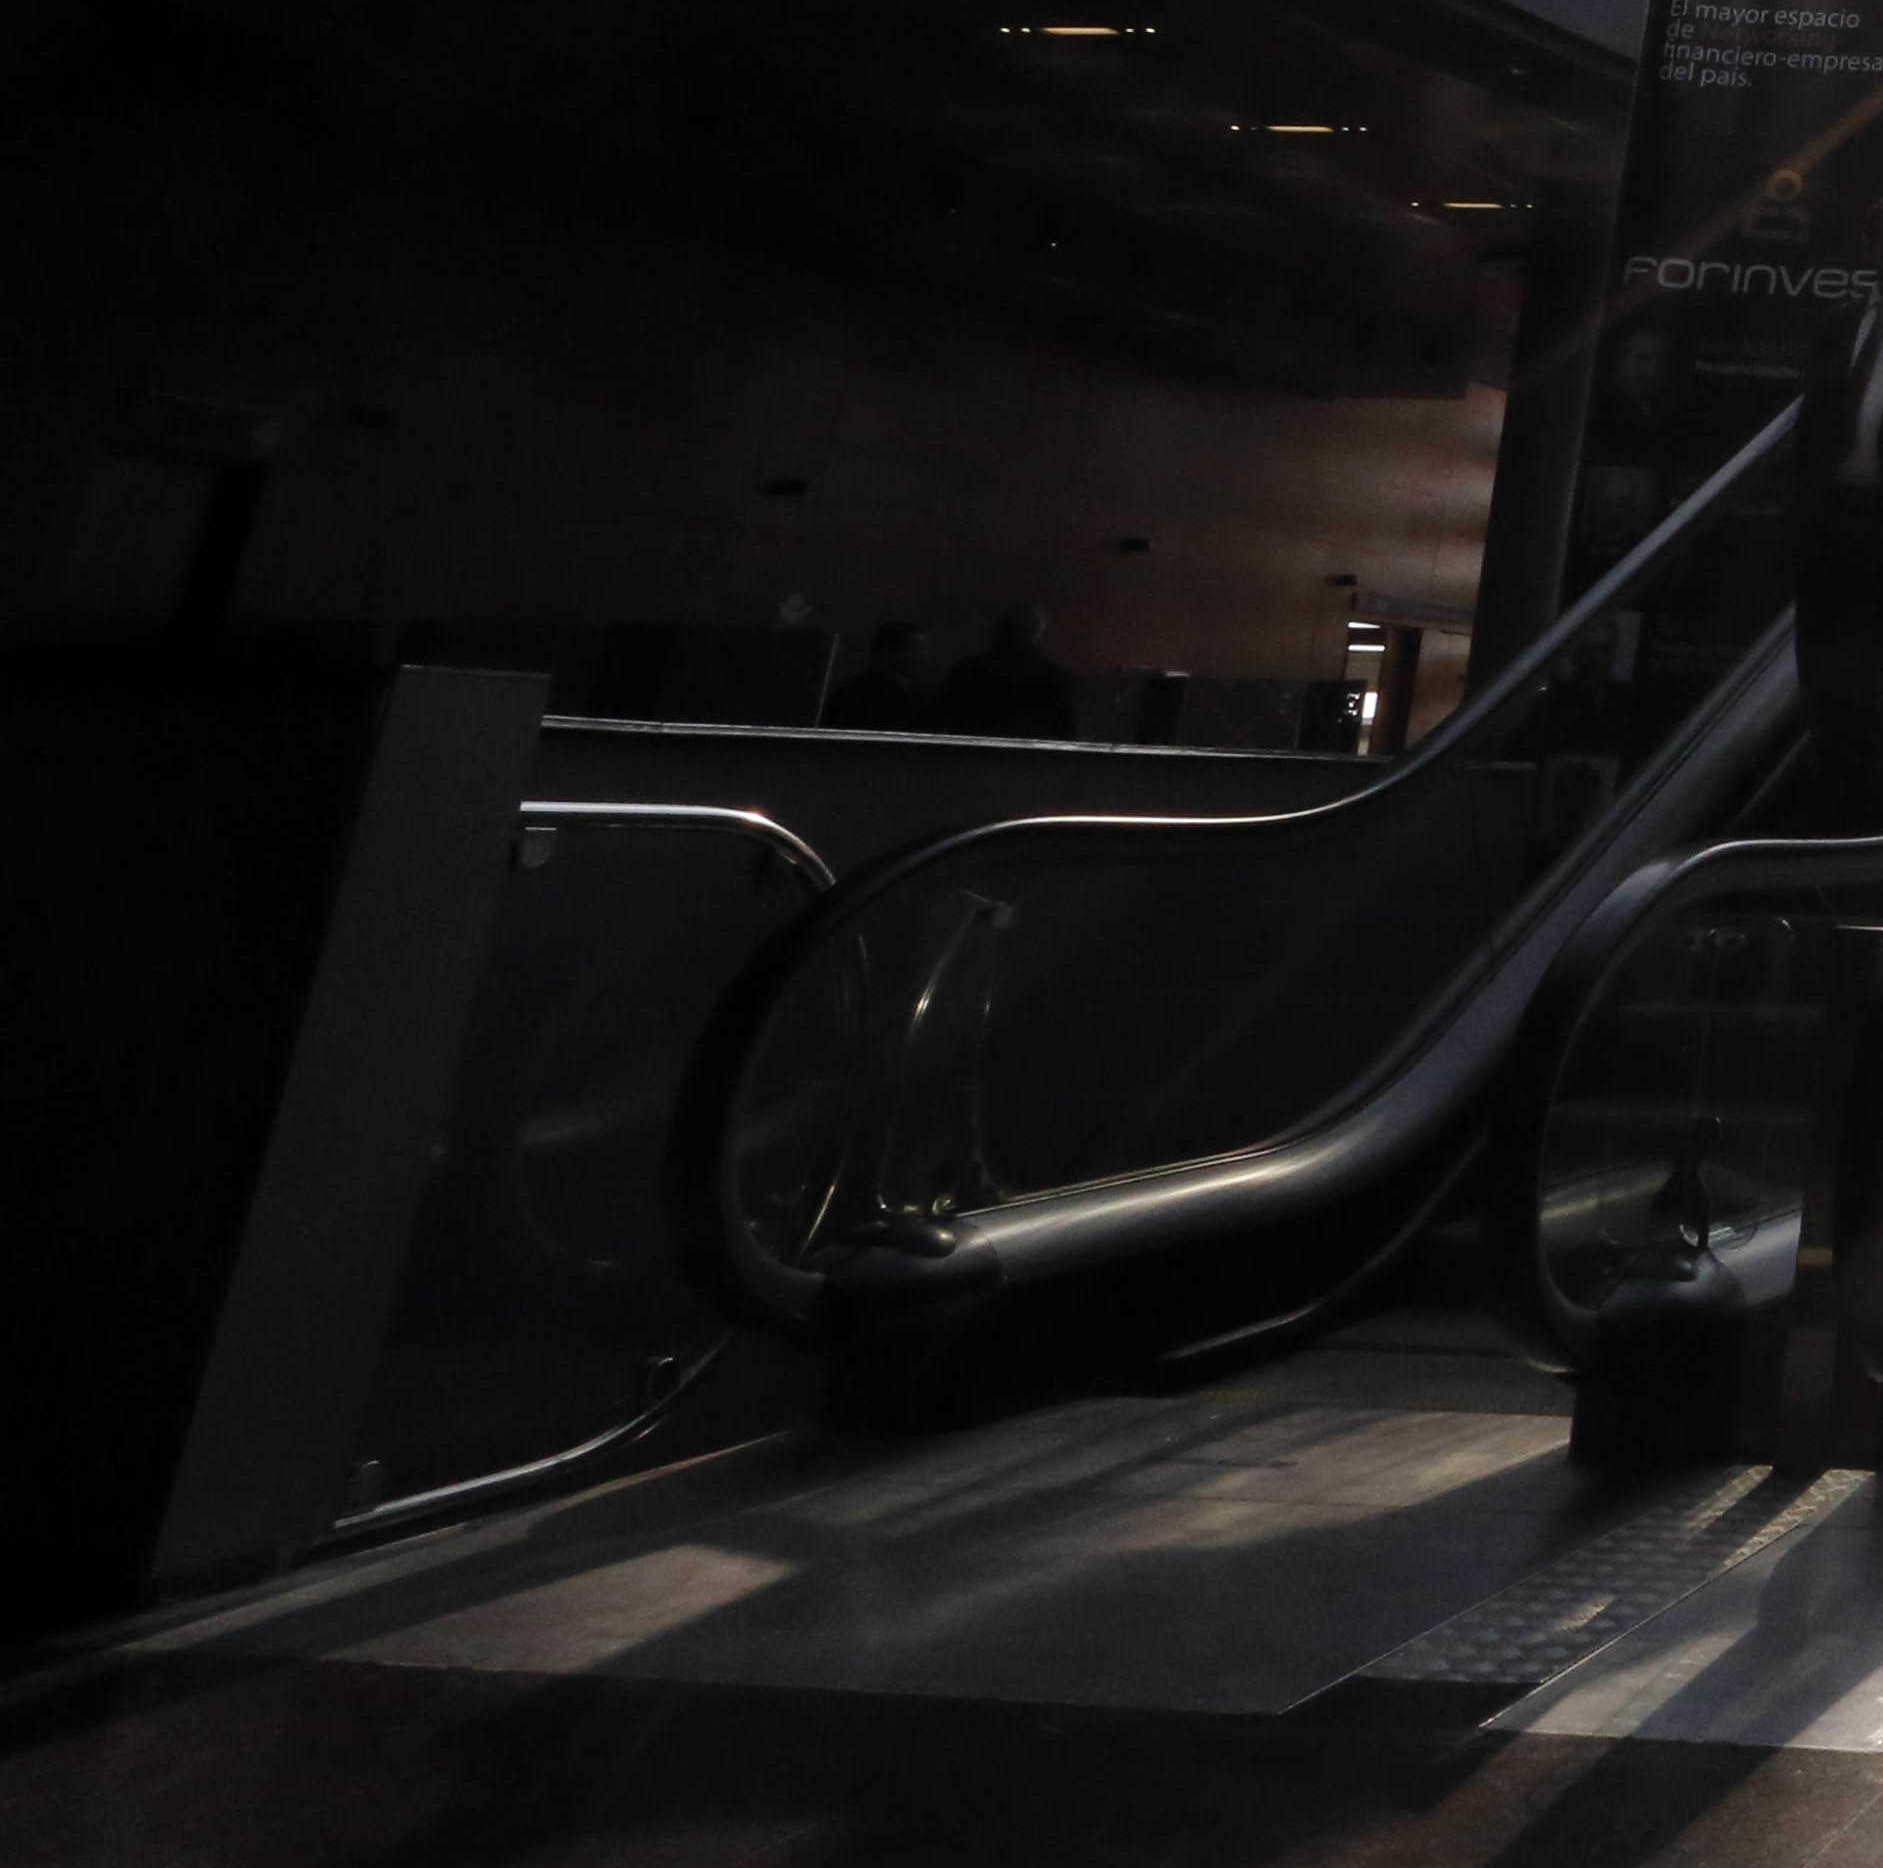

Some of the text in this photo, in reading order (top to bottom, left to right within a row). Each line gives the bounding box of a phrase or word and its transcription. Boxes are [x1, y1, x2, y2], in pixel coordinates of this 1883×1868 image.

[1695, 4, 1769, 28] mayor
[1774, 8, 1861, 30] espacio
[1666, 20, 1695, 40] de
[1659, 62, 1694, 82] del
